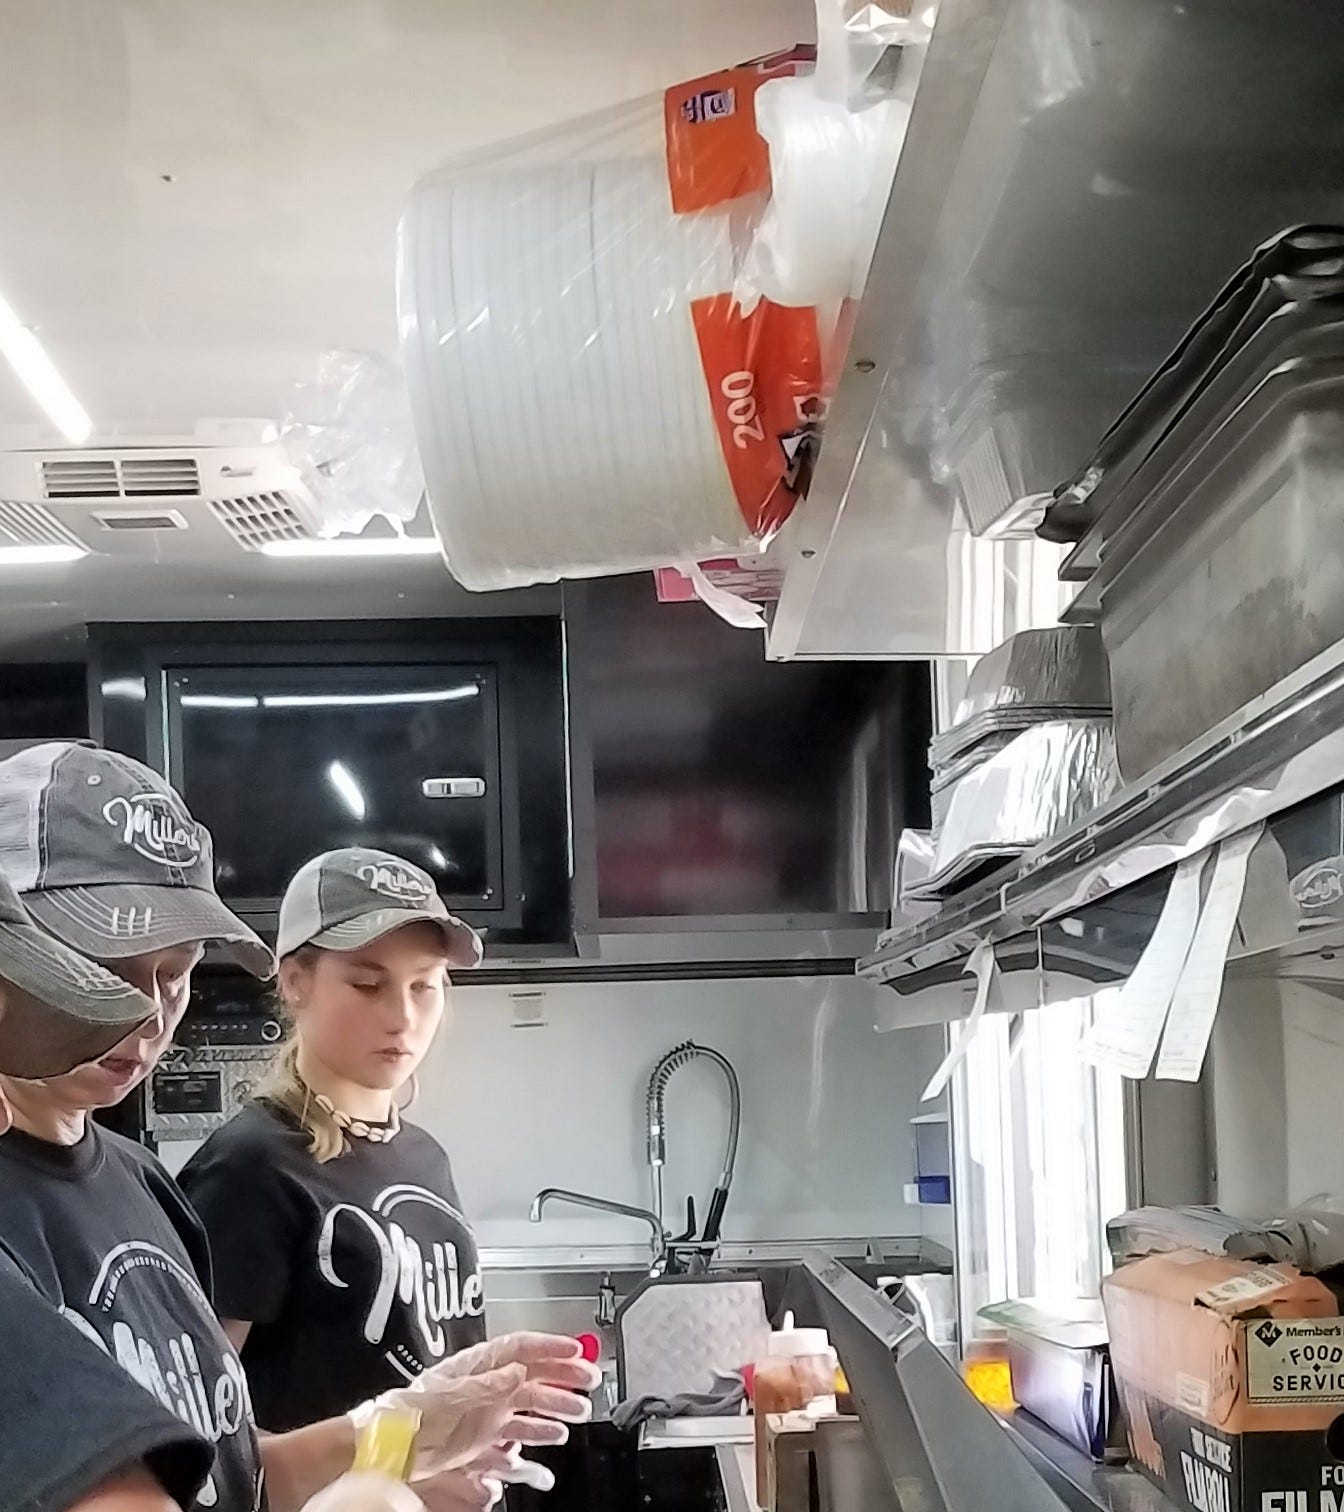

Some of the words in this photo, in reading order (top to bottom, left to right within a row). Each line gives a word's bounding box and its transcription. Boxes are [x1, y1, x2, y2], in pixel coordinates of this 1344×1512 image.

[721, 371, 765, 449] 200
[318, 1203, 484, 1357] Mille
[1286, 1326, 1341, 1337] Member's
[1289, 1345, 1343, 1365] FOOD
